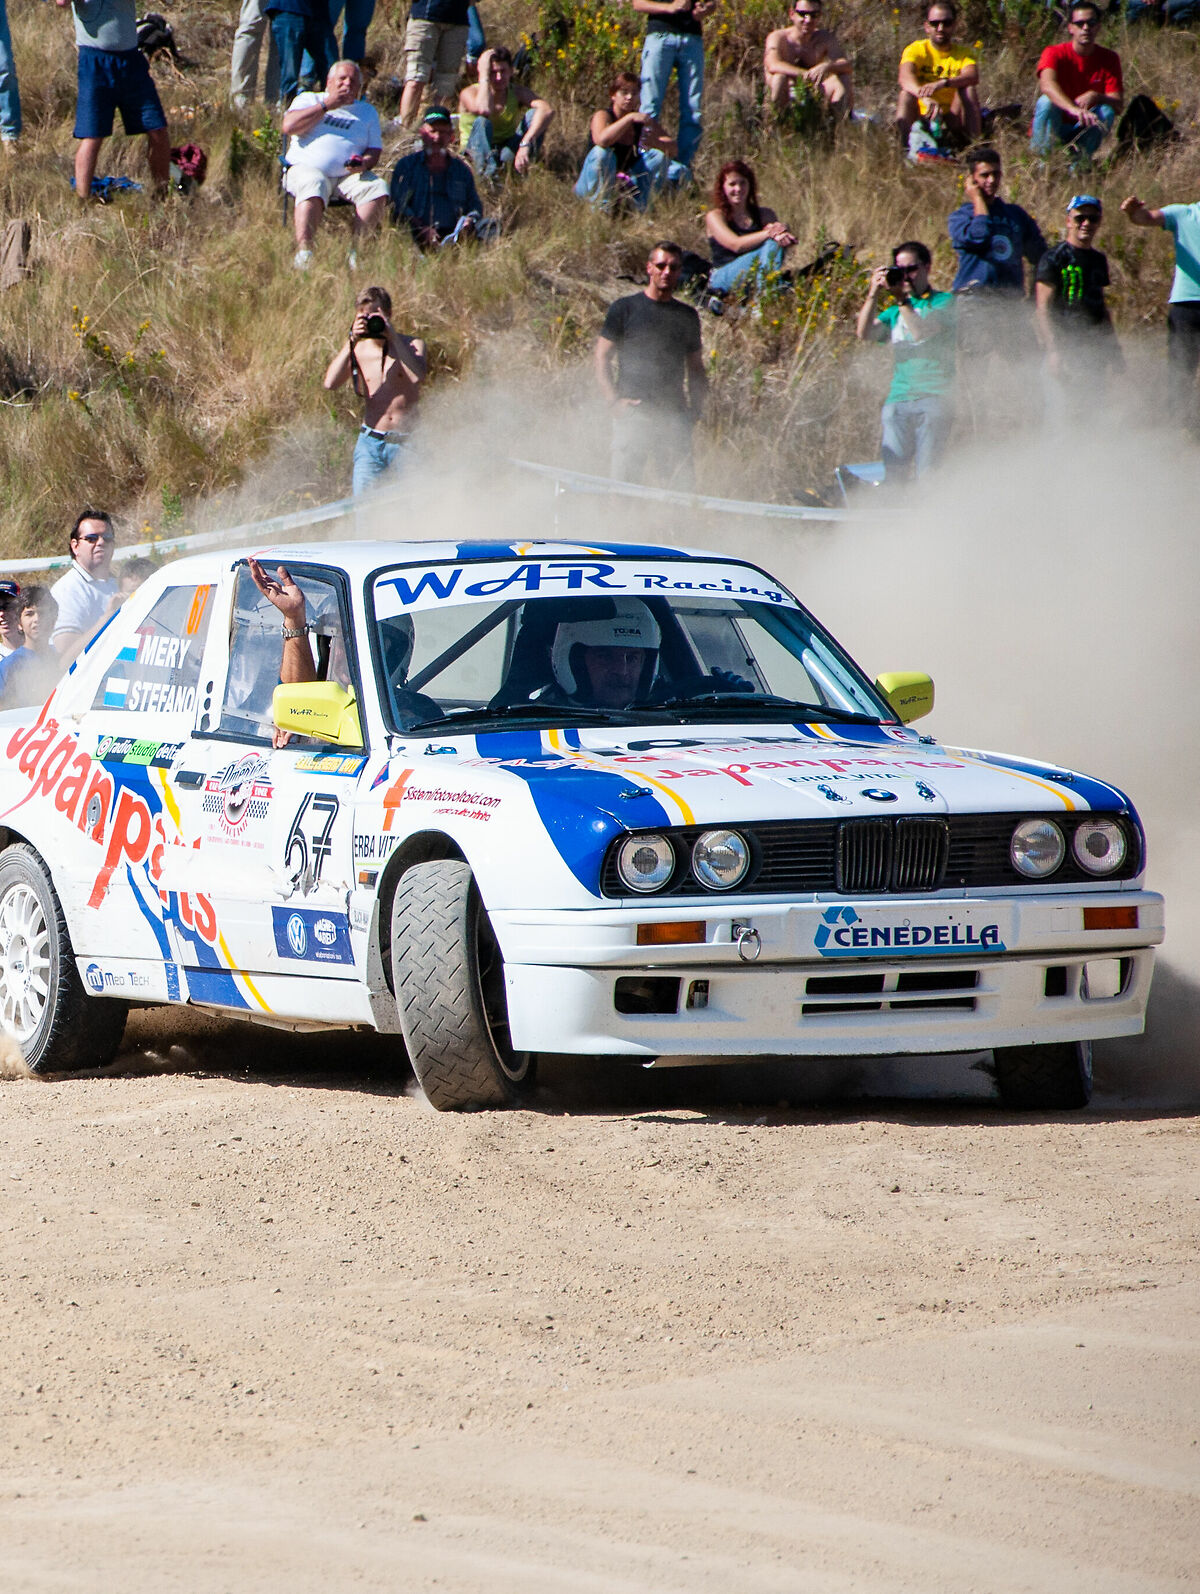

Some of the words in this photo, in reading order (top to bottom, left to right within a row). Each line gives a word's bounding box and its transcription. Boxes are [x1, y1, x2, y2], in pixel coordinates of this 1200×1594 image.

[376, 563, 627, 606] WAR
[633, 574, 790, 603] Racing
[186, 584, 210, 635] 67
[140, 634, 192, 669] MERY
[128, 680, 196, 713] STEFANO
[129, 743, 157, 757] studio
[284, 791, 340, 893] 67
[354, 835, 375, 858] ERBA
[833, 924, 1000, 950] CENEDELLA
